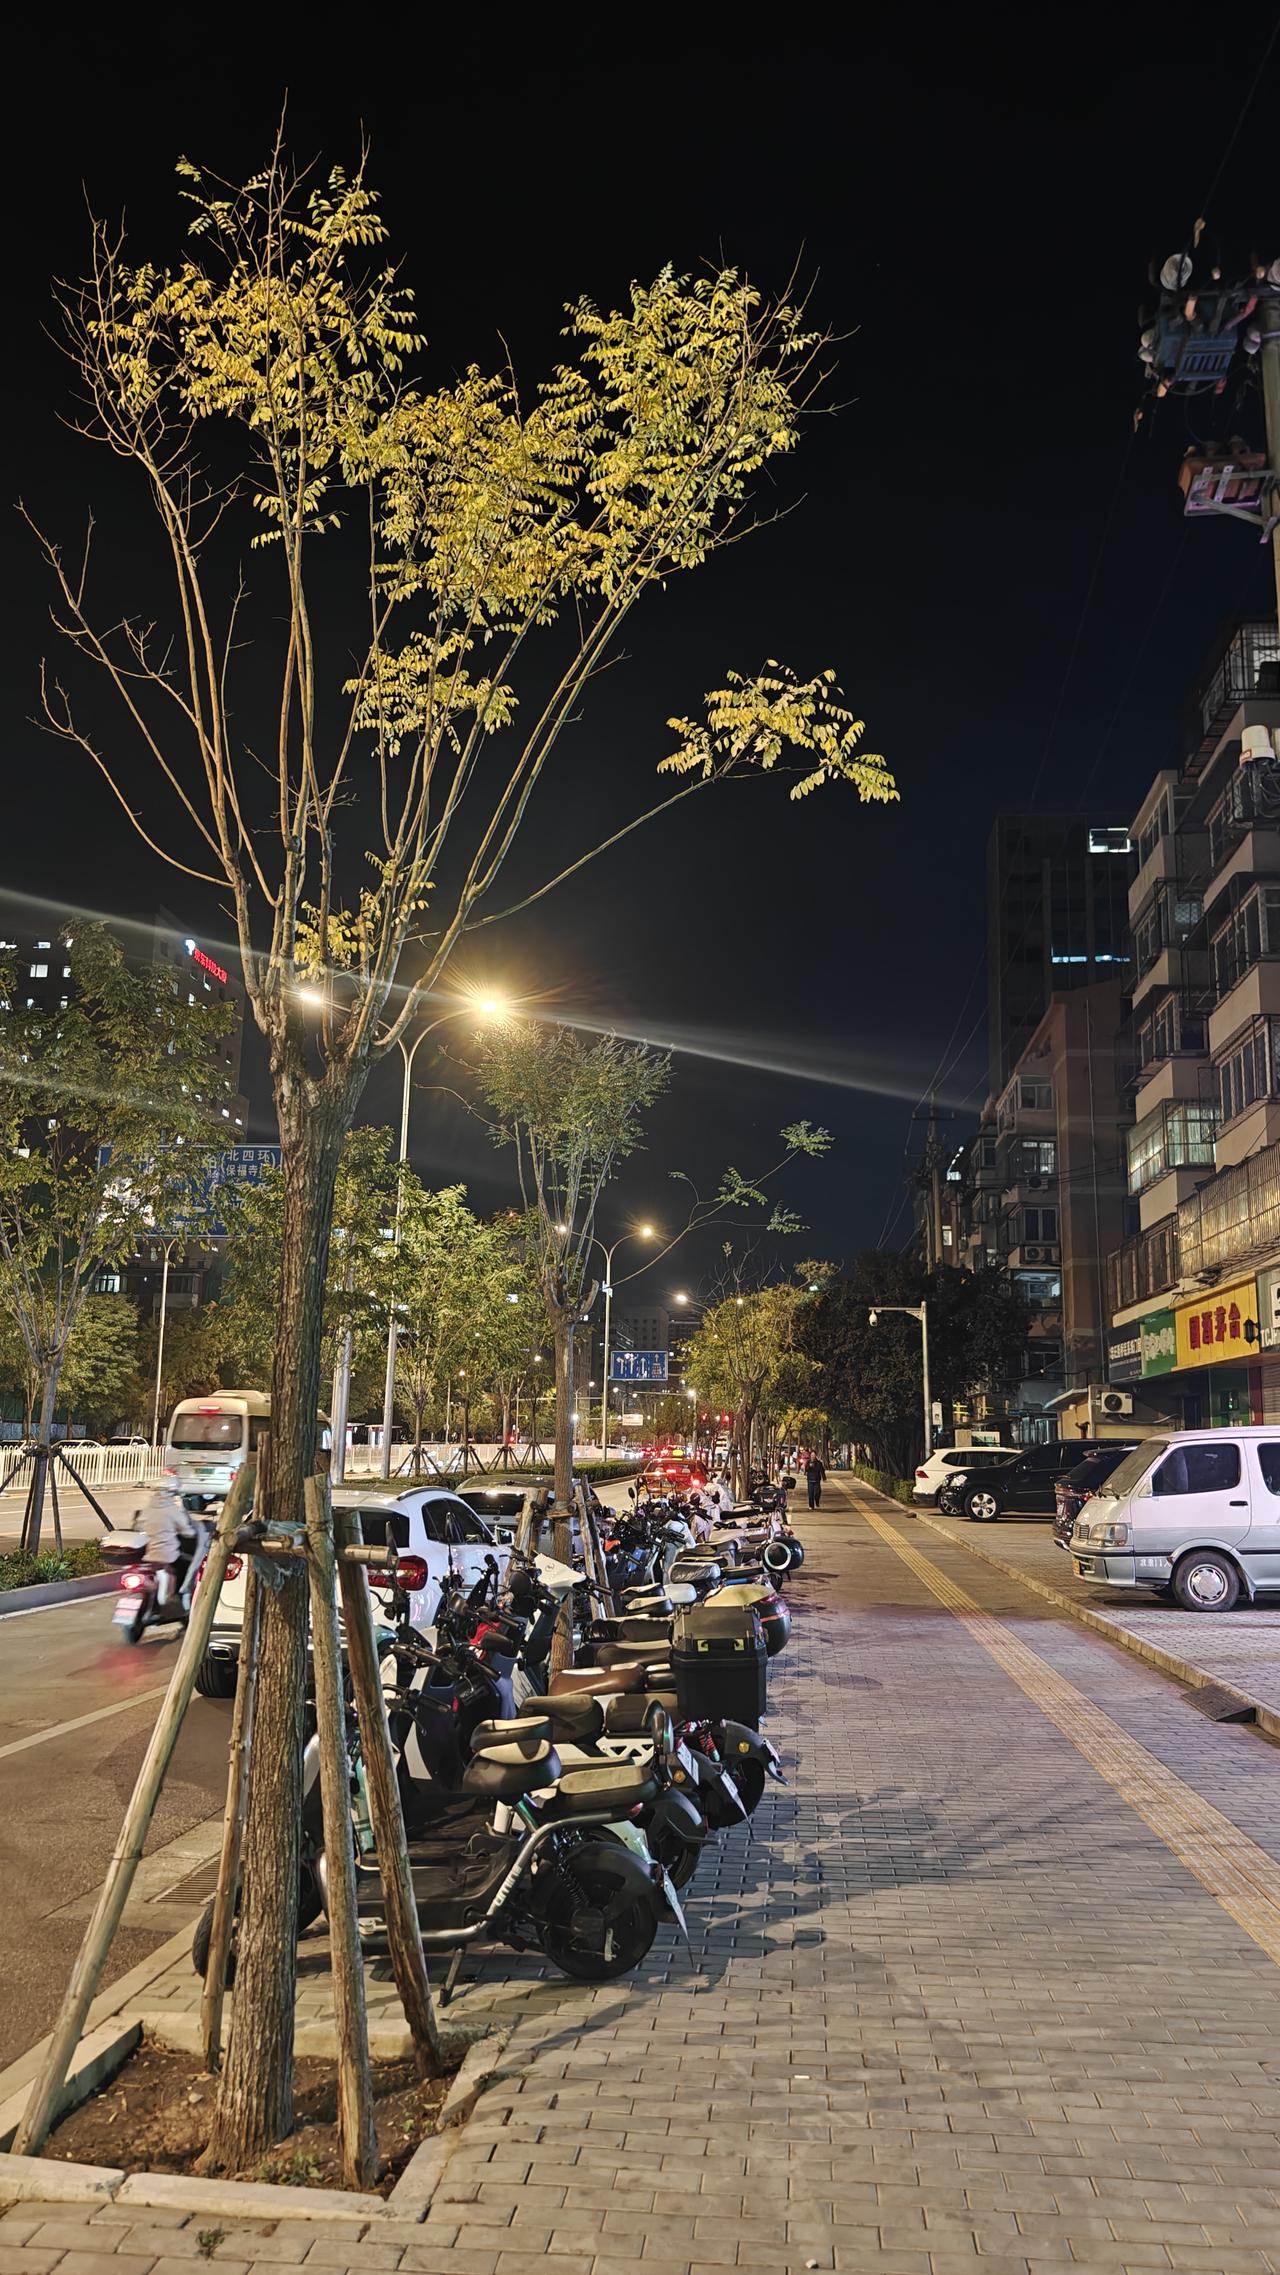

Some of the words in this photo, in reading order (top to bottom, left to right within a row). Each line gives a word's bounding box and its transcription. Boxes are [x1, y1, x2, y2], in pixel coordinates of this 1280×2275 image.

[227, 1150, 271, 1162] 北四环
[226, 1164, 266, 1178] 保福寺
